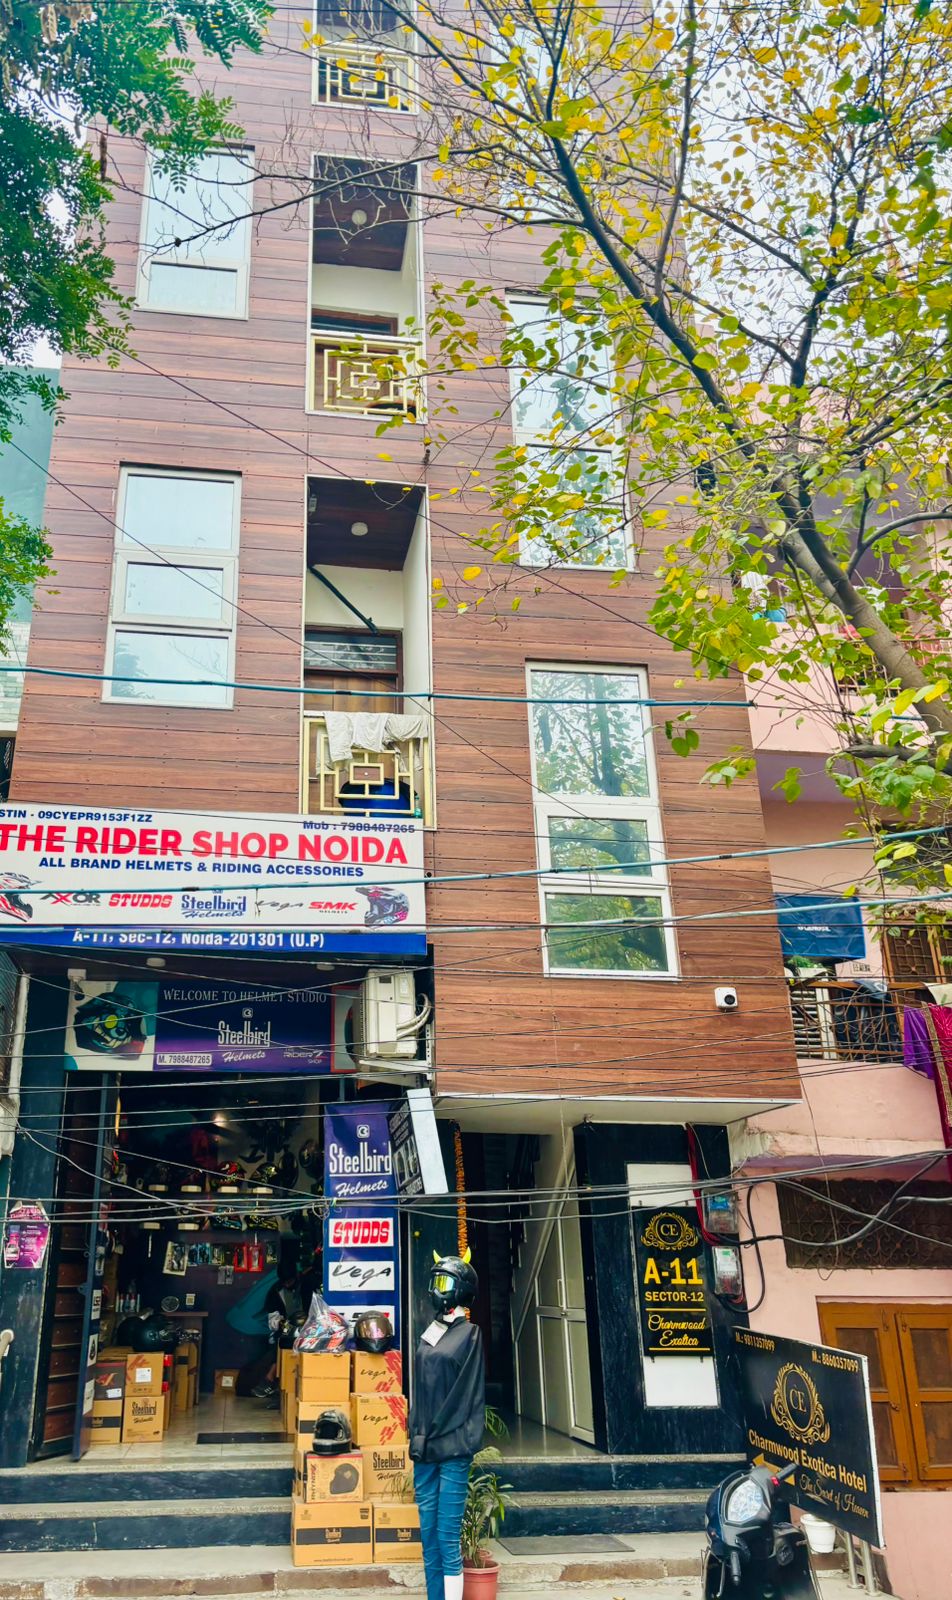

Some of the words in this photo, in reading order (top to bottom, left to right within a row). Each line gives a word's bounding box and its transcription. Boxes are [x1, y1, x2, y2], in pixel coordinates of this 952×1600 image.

[38, 810, 153, 823] 09CYEPR9153F1ZZ
[303, 821, 329, 830] Mob
[0, 824, 67, 853] THE
[75, 826, 183, 857] RIDER
[192, 830, 289, 859] SHOP
[299, 834, 408, 864] NOIDA
[39, 857, 66, 868] ALL
[70, 858, 121, 869] BRAND
[125, 860, 192, 872] HELMETS
[197, 862, 207, 872] &
[212, 863, 262, 874] RIDING
[266, 864, 364, 877] ACCESSORIES
[109, 893, 173, 908] STUDDS
[181, 894, 247, 912] Steelbird
[308, 901, 358, 911] SMK
[290, 933, 325, 948] (U.P)
[164, 989, 218, 1001] WELCOME
[222, 991, 237, 1001] TO
[287, 992, 327, 1003] STUDIO
[218, 1021, 271, 1047] Steelbird
[222, 1051, 266, 1063] Helmets
[329, 1141, 392, 1174] Steelbird
[335, 1181, 389, 1197] Helmets
[333, 1221, 390, 1244] STUDDS
[660, 1223, 679, 1236] CE
[644, 1257, 704, 1285] A-11
[645, 1291, 704, 1302] SECTOR-12
[659, 1330, 699, 1347] Exotica
[373, 1451, 405, 1469] Steelbird
[748, 1429, 799, 1464] Charmwood
[801, 1449, 837, 1480] Exotica
[838, 1465, 867, 1493] Hotel
